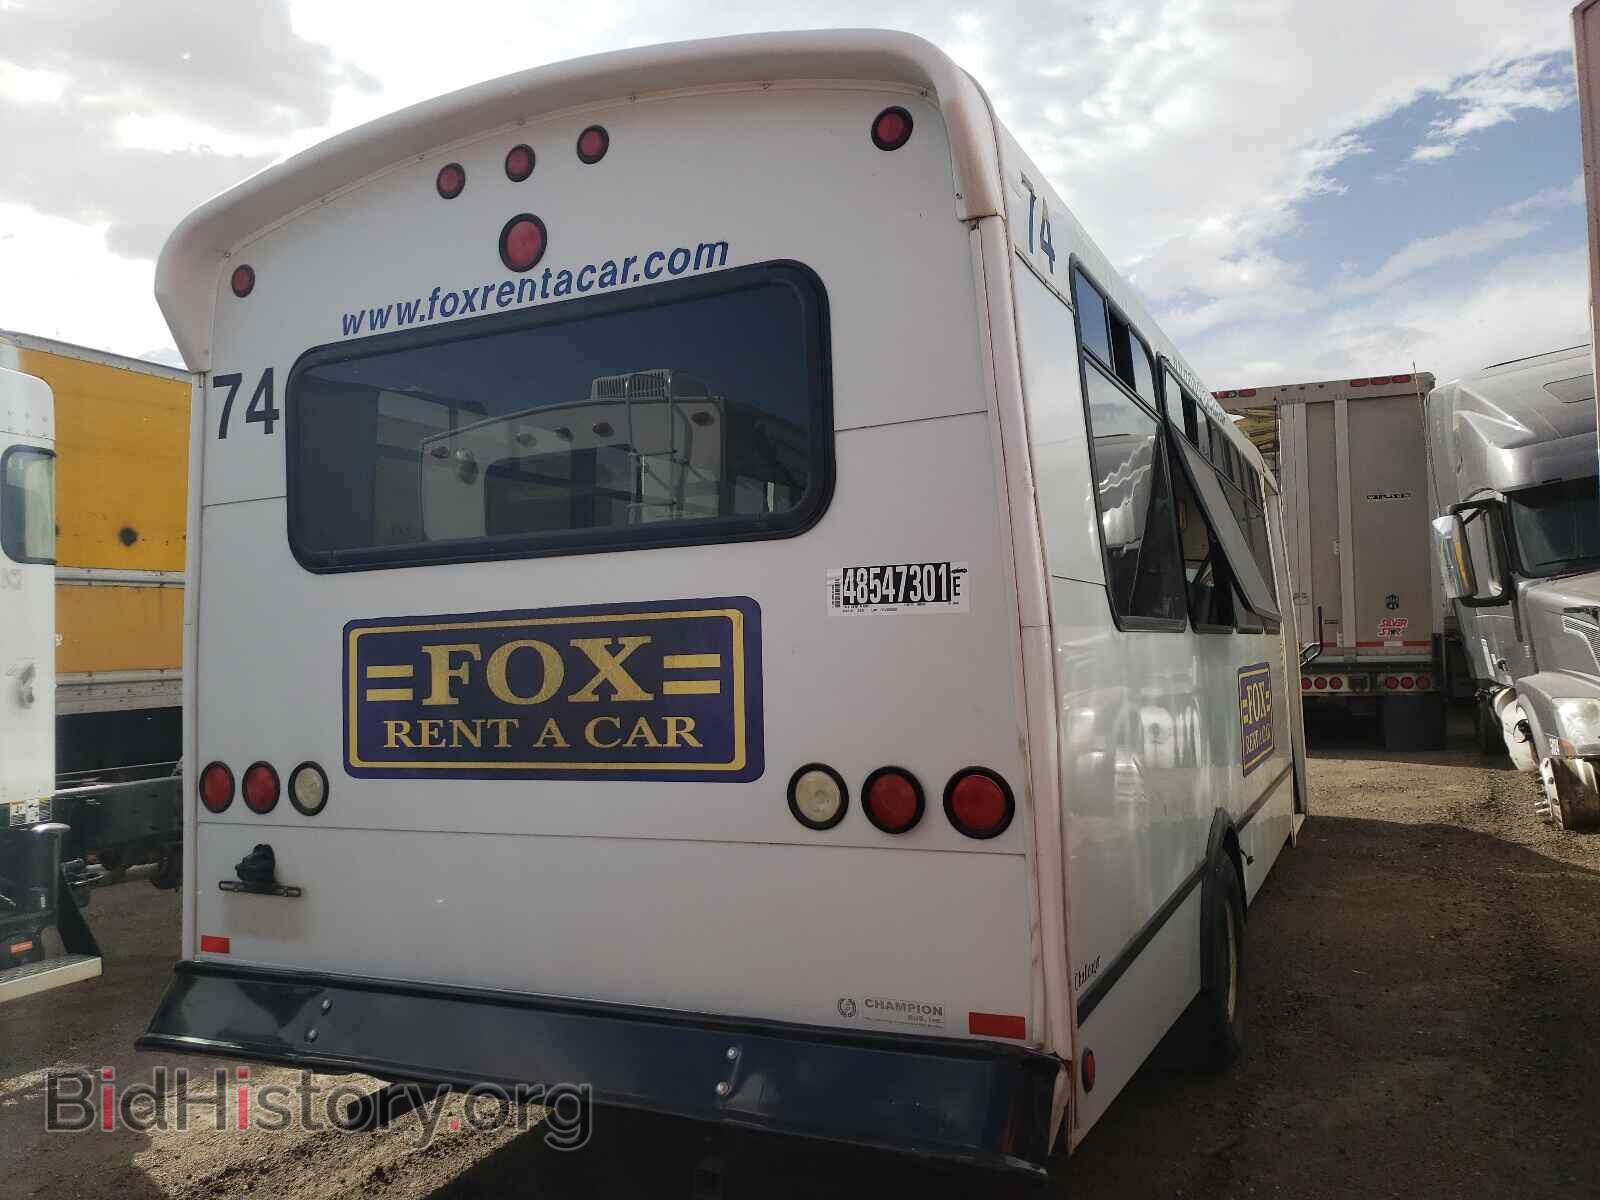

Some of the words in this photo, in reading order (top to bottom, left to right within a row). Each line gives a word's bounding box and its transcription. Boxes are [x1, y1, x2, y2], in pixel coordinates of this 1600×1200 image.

[1020, 169, 1056, 274] 74
[341, 240, 729, 335] www.foxrentacar.com
[212, 368, 280, 440] 74
[843, 563, 949, 604] 48547301
[421, 635, 655, 706] FOX
[1247, 681, 1267, 724] FOX
[383, 718, 519, 749] RENT
[532, 716, 571, 748] A
[584, 716, 704, 748] CAR
[864, 998, 943, 1017] CHAMPION
